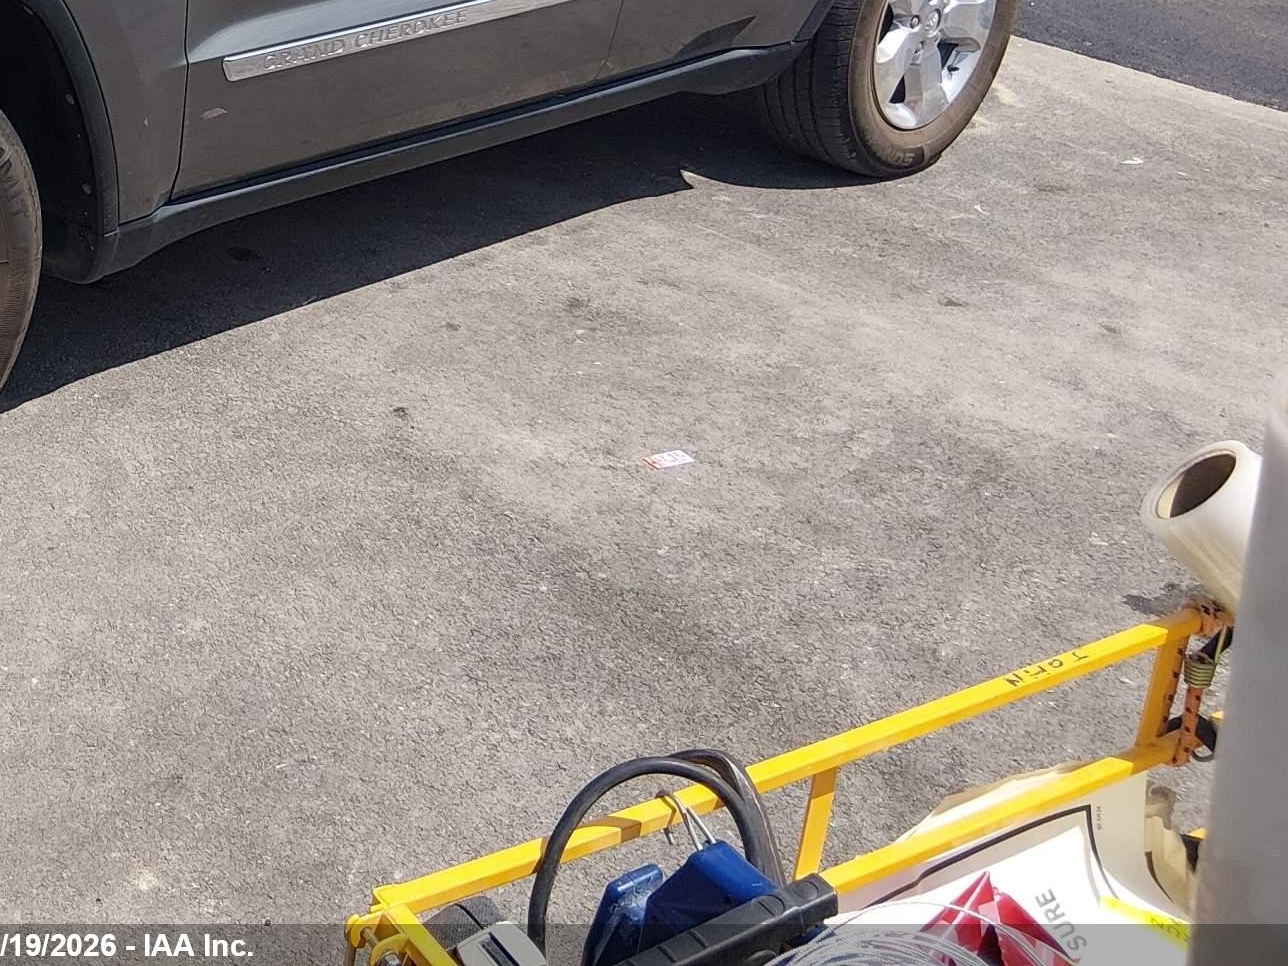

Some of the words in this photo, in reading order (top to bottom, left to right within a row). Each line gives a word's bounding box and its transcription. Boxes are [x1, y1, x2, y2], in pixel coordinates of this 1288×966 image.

[263, 38, 346, 71] GRAND
[354, 10, 469, 49] CHEROKEE
[1035, 888, 1088, 951] SURE
